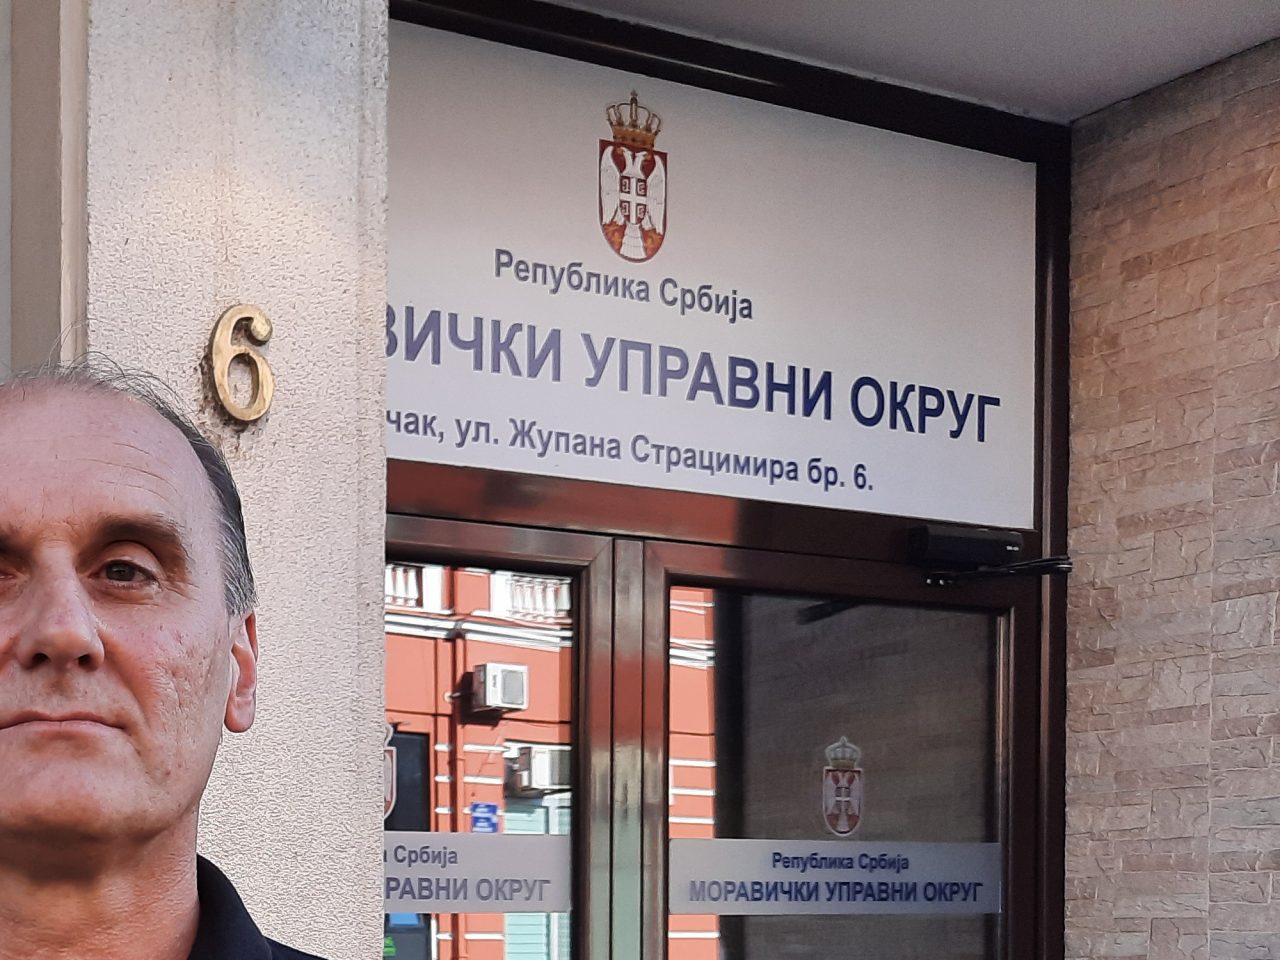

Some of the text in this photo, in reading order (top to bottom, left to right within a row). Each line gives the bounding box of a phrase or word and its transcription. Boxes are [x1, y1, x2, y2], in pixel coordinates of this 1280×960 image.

[495, 249, 753, 324] Република Србија
[210, 304, 274, 421] 6
[581, 332, 832, 421] УПРАВНИ
[850, 376, 1001, 442] ОКРУГ
[455, 418, 499, 449] ул.
[509, 418, 621, 460] Жупана
[631, 435, 799, 485] Страцимира
[807, 458, 845, 492] бр.
[854, 463, 873, 491] 6.
[394, 845, 458, 868] Србија
[772, 852, 910, 874] Република Србија
[476, 878, 551, 901] ОКРУГ
[689, 880, 983, 902] МОРАВИЧКИ УПРАВНИ ОКРУГ
